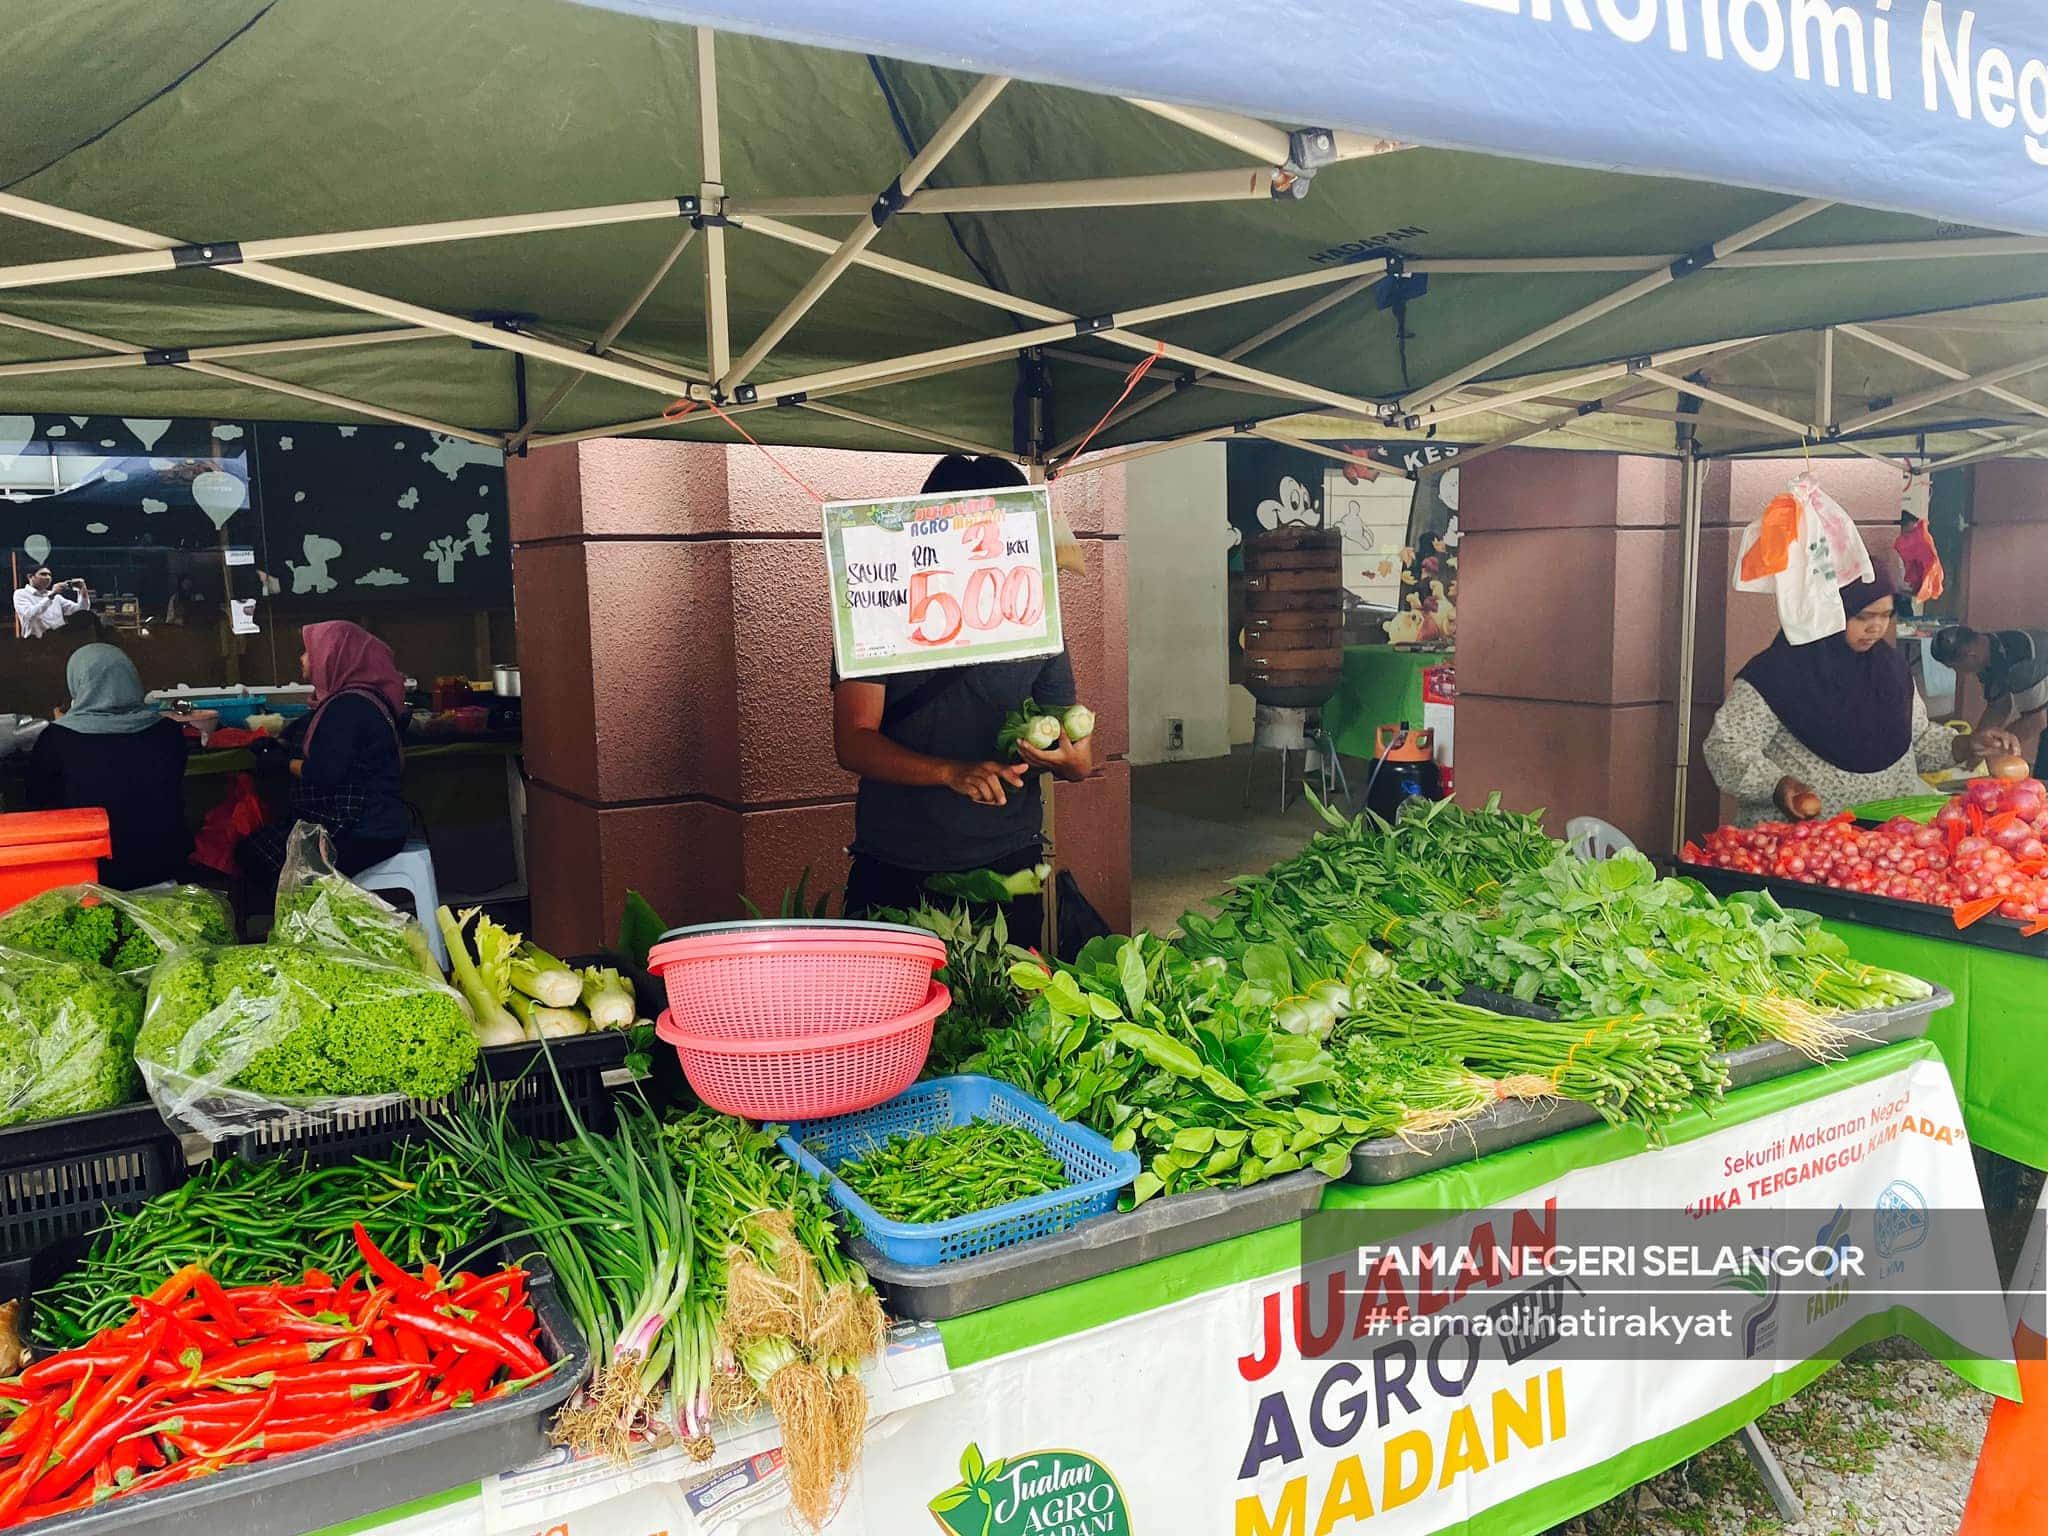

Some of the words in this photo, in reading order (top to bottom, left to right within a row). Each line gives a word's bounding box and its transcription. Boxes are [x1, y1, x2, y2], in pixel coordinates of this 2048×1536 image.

[911, 519, 949, 537] AGRO
[844, 589, 908, 610] SAYURAN
[846, 562, 900, 586] SAYUR
[1724, 1139, 1785, 1177] Sekuriti
[1788, 1116, 1866, 1155] Makanan
[1237, 1196, 1557, 1382] JUALAN
[1806, 1277, 1849, 1325] FAMA
[1237, 1318, 1481, 1480] AGRO
[995, 1460, 1094, 1524] Jualan
[1022, 1483, 1114, 1535] AGRO
